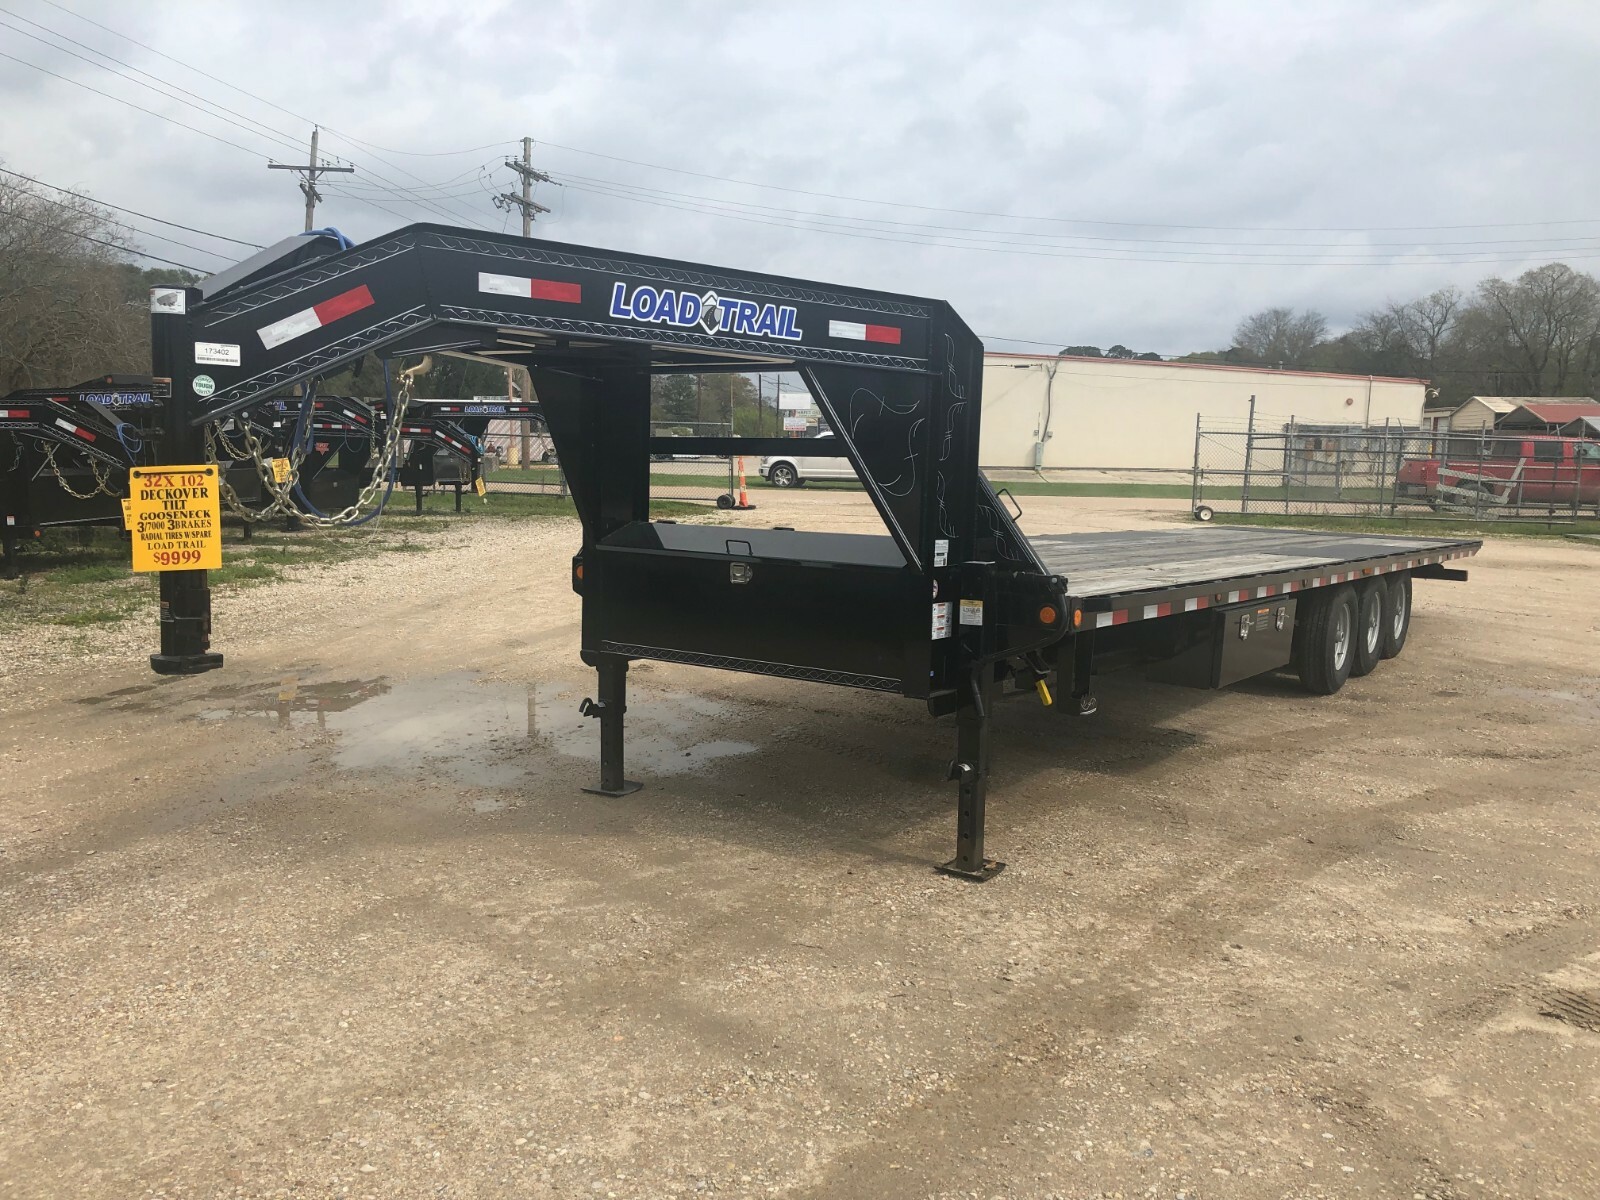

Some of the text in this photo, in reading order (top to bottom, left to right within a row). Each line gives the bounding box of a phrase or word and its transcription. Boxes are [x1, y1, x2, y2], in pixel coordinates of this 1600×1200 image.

[609, 281, 803, 341] LOAD TRAIL
[204, 347, 230, 356] 173402
[119, 393, 154, 404] TRAIL
[181, 474, 204, 487] 102
[140, 488, 209, 501] DECKOVER
[162, 500, 187, 510] TILT
[140, 510, 211, 521] GOOSENECK
[137, 521, 166, 533] 3/7000
[140, 532, 163, 541] RADIAL
[165, 531, 183, 540] TIRES
[147, 540, 207, 551] LOAD TRAIL
[153, 549, 202, 566] $9999
